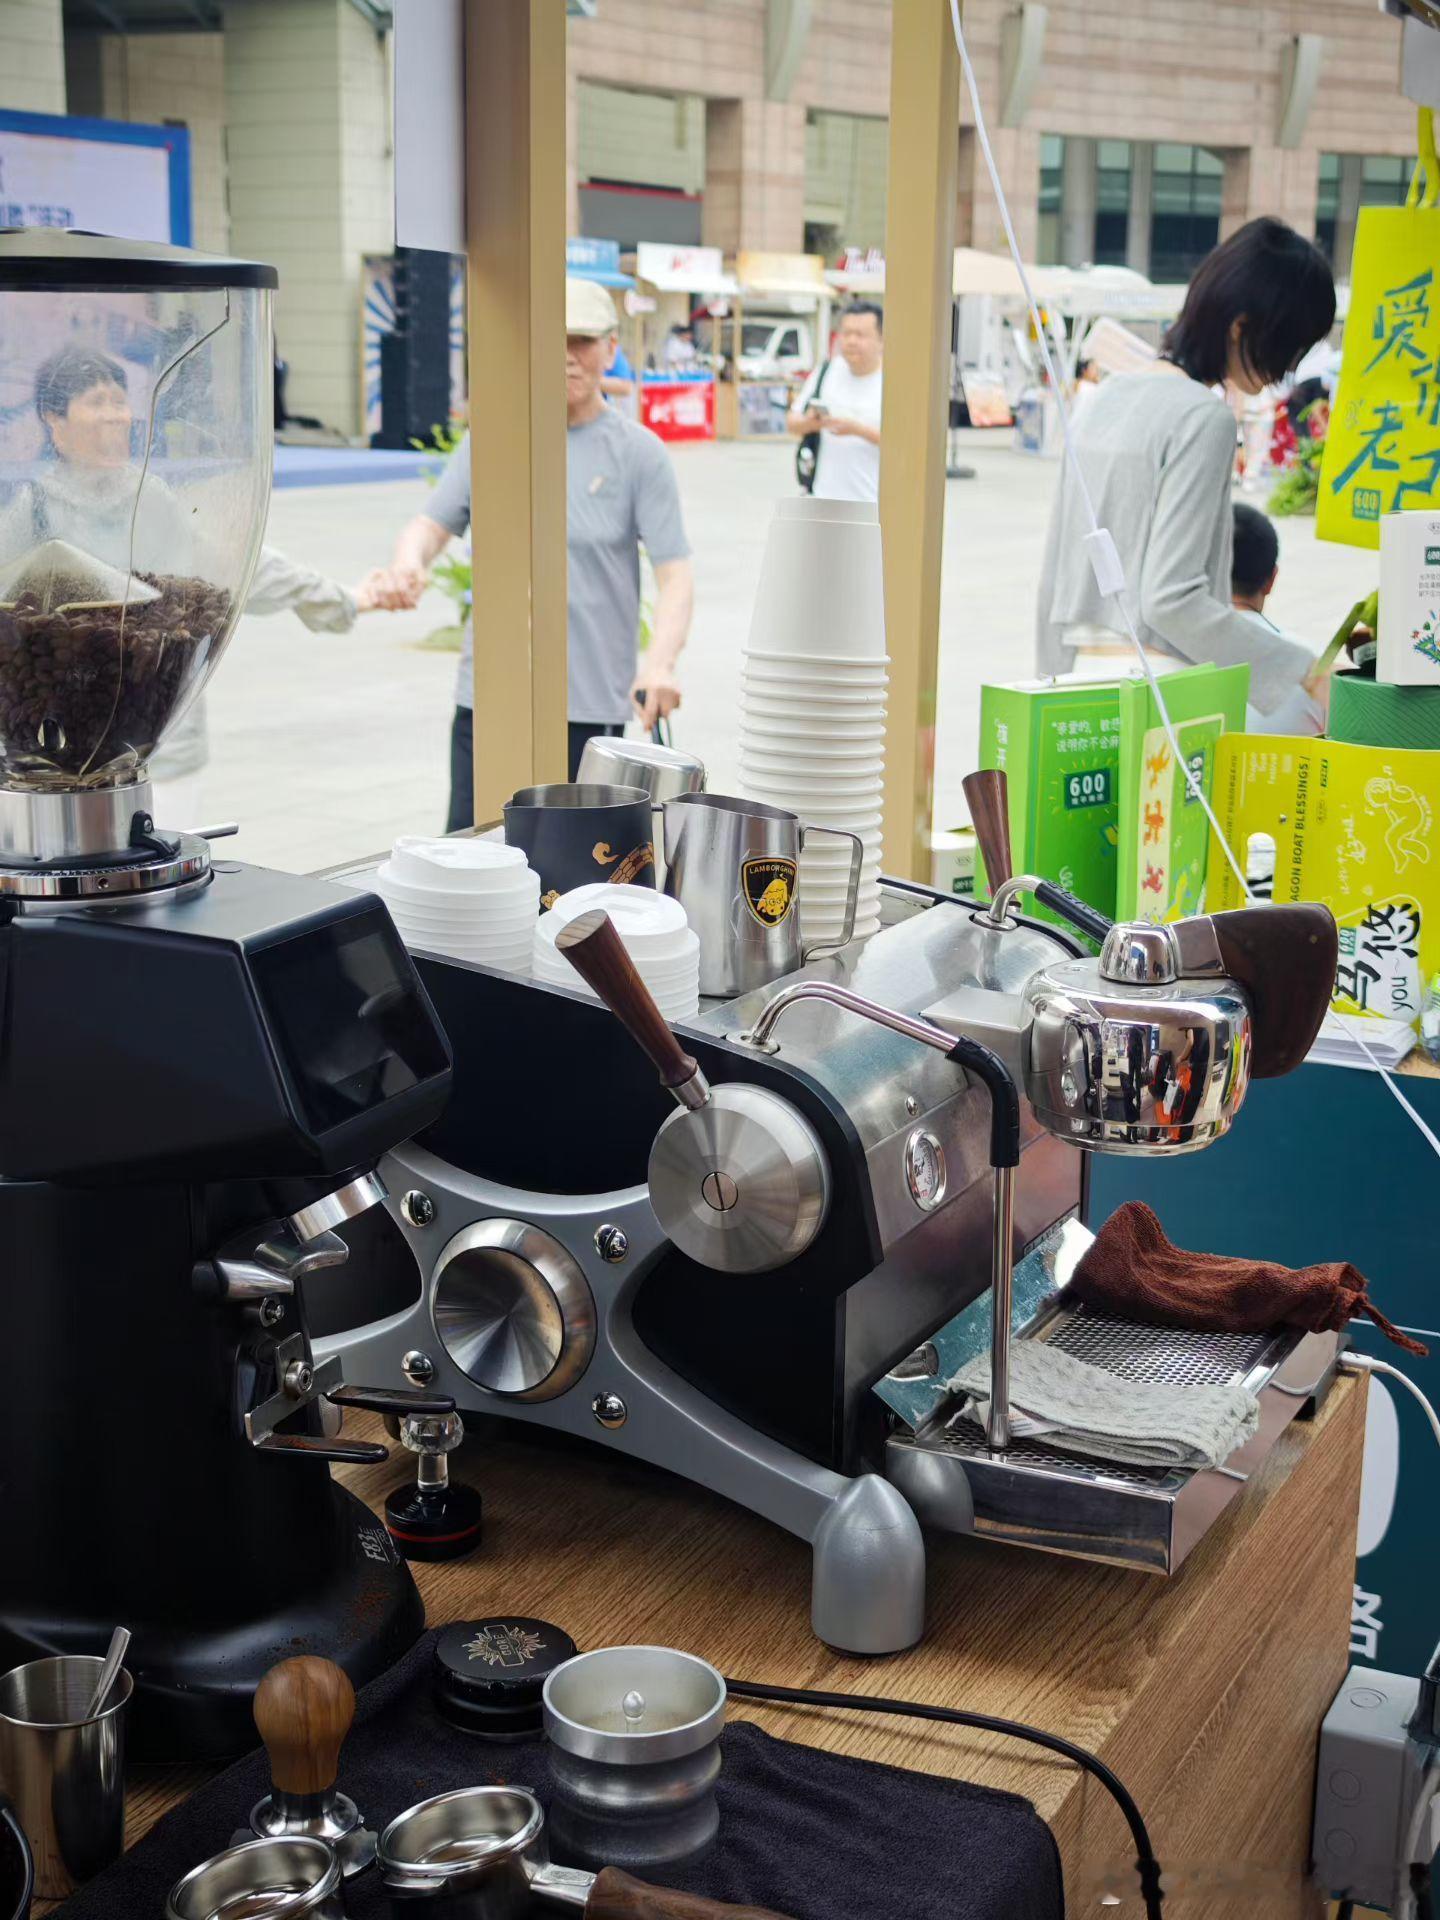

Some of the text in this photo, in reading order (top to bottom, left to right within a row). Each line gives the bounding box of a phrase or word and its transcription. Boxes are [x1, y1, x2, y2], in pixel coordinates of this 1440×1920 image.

[1354, 490, 1378, 507] 600
[1069, 773, 1105, 797] 600
[1294, 762, 1309, 831] BLESSINGS
[1291, 833, 1304, 865] BOAT
[1289, 867, 1302, 902] AGON
[493, 1633, 512, 1656] CORE
